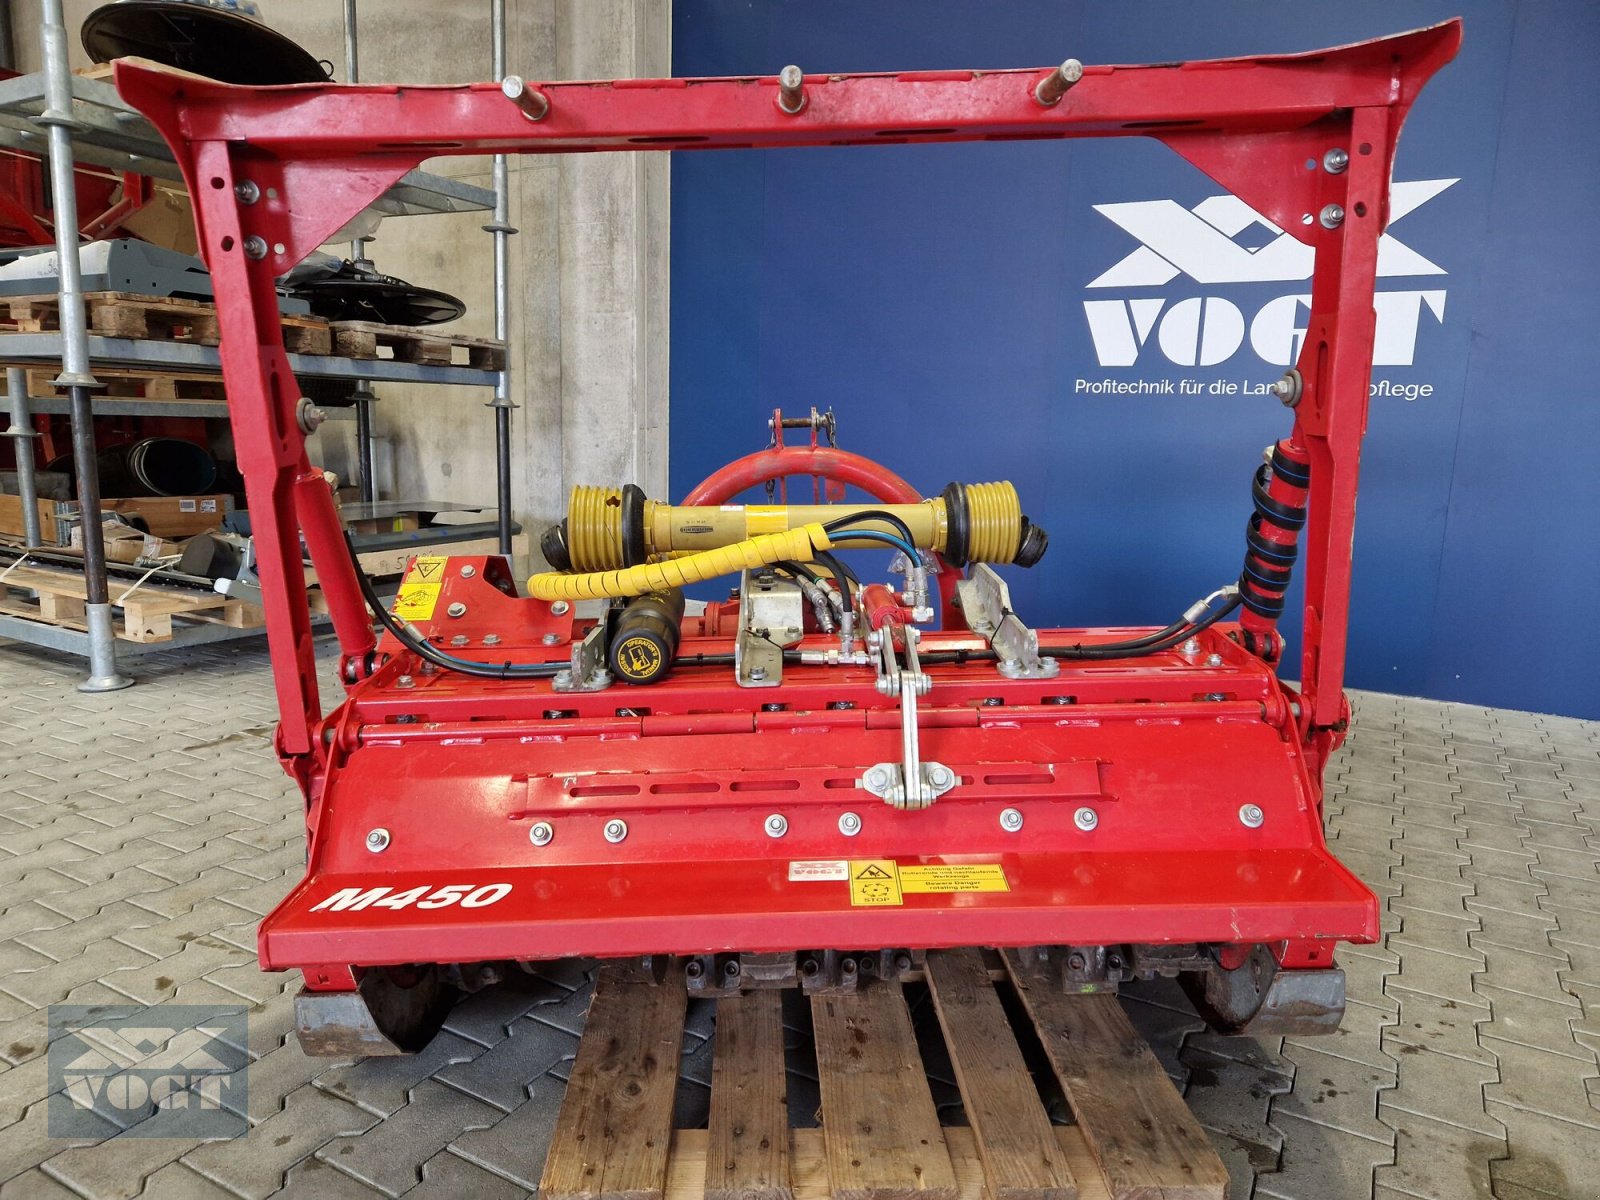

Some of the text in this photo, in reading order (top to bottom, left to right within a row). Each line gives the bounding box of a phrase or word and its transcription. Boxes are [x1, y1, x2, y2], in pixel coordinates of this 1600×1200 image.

[1083, 290, 1447, 367] VOGT
[1075, 378, 1174, 395] Profitechnik
[1180, 378, 1204, 395] für
[1209, 379, 1238, 395] die
[620, 639, 659, 676] OPERATOR'S MANUAL INSIDE
[308, 883, 513, 913] M450
